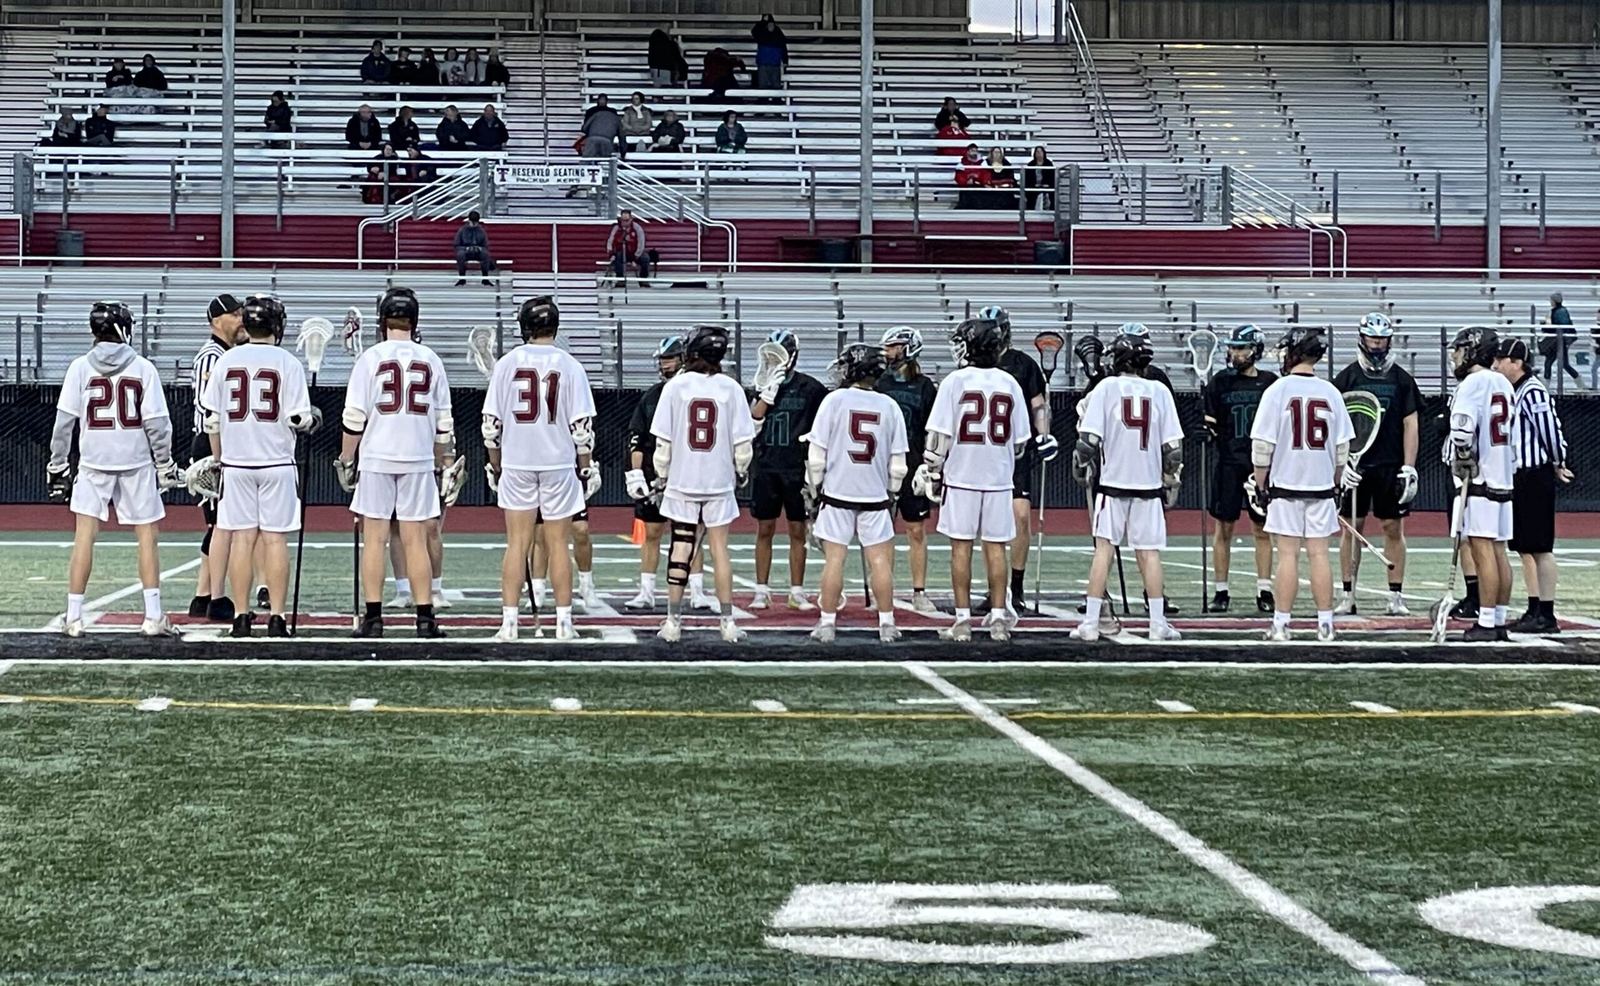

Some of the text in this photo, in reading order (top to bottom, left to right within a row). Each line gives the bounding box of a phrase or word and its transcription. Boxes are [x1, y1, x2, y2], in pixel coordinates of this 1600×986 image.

[511, 168, 585, 177] RESERVED SEATING
[86, 376, 143, 430] 20
[225, 367, 281, 423] 33
[375, 360, 433, 416] 32
[512, 368, 561, 426] 31
[687, 397, 718, 453] 8
[765, 410, 790, 447] 11
[847, 409, 881, 465] 5
[956, 390, 1016, 447] 28
[1121, 396, 1152, 452] 4
[1286, 396, 1332, 450] 16
[763, 882, 1217, 965] 5
